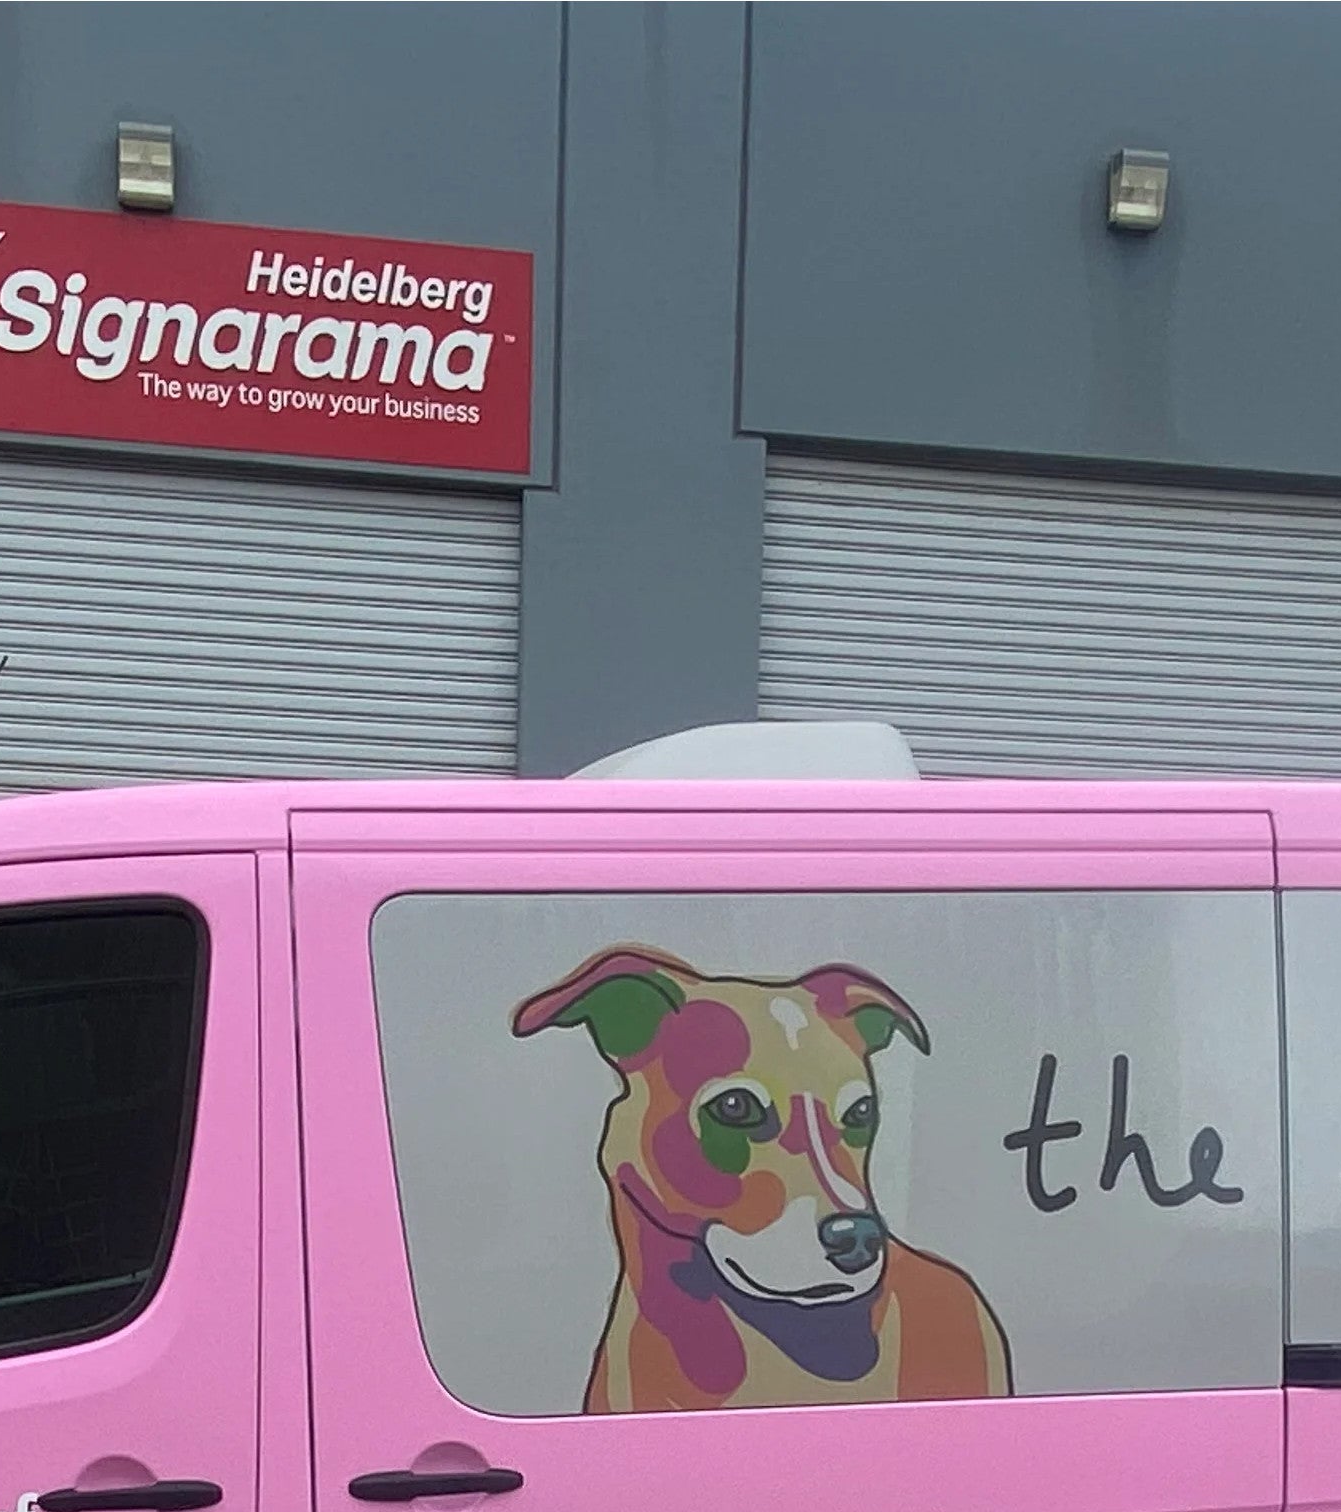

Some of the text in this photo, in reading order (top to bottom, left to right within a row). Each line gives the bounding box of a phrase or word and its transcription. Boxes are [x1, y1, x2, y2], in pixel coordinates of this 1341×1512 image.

[246, 250, 494, 324] Heidelberg
[138, 372, 481, 424] The way to grow your business
[1004, 1051, 1244, 1213] the
